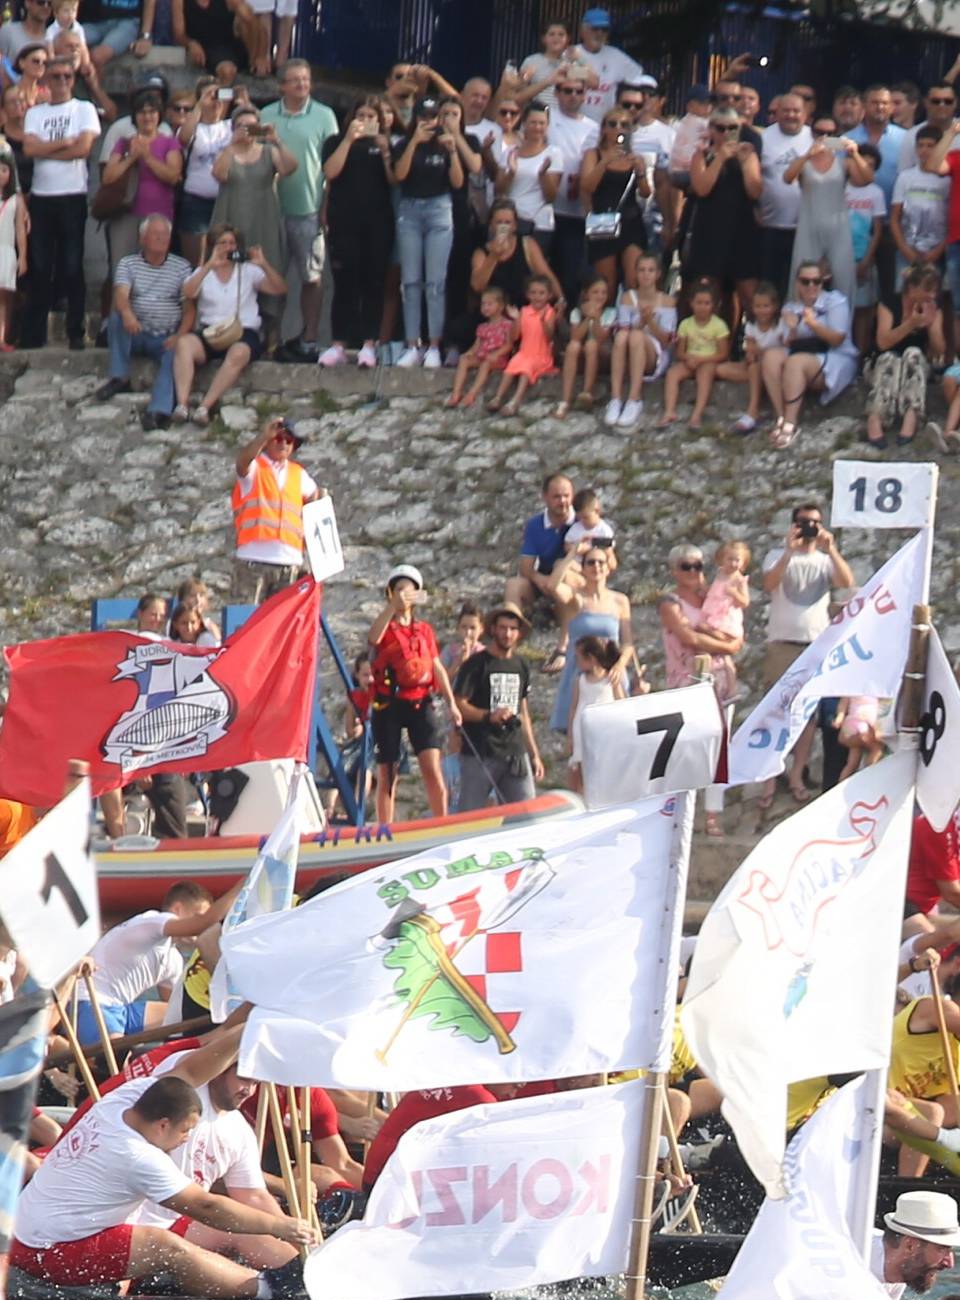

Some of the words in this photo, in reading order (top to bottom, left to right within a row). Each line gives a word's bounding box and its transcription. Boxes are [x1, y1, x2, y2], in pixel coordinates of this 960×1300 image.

[849, 477, 903, 513] 18
[314, 516, 338, 555] 17
[635, 711, 685, 781] 7
[917, 690, 946, 767] 8
